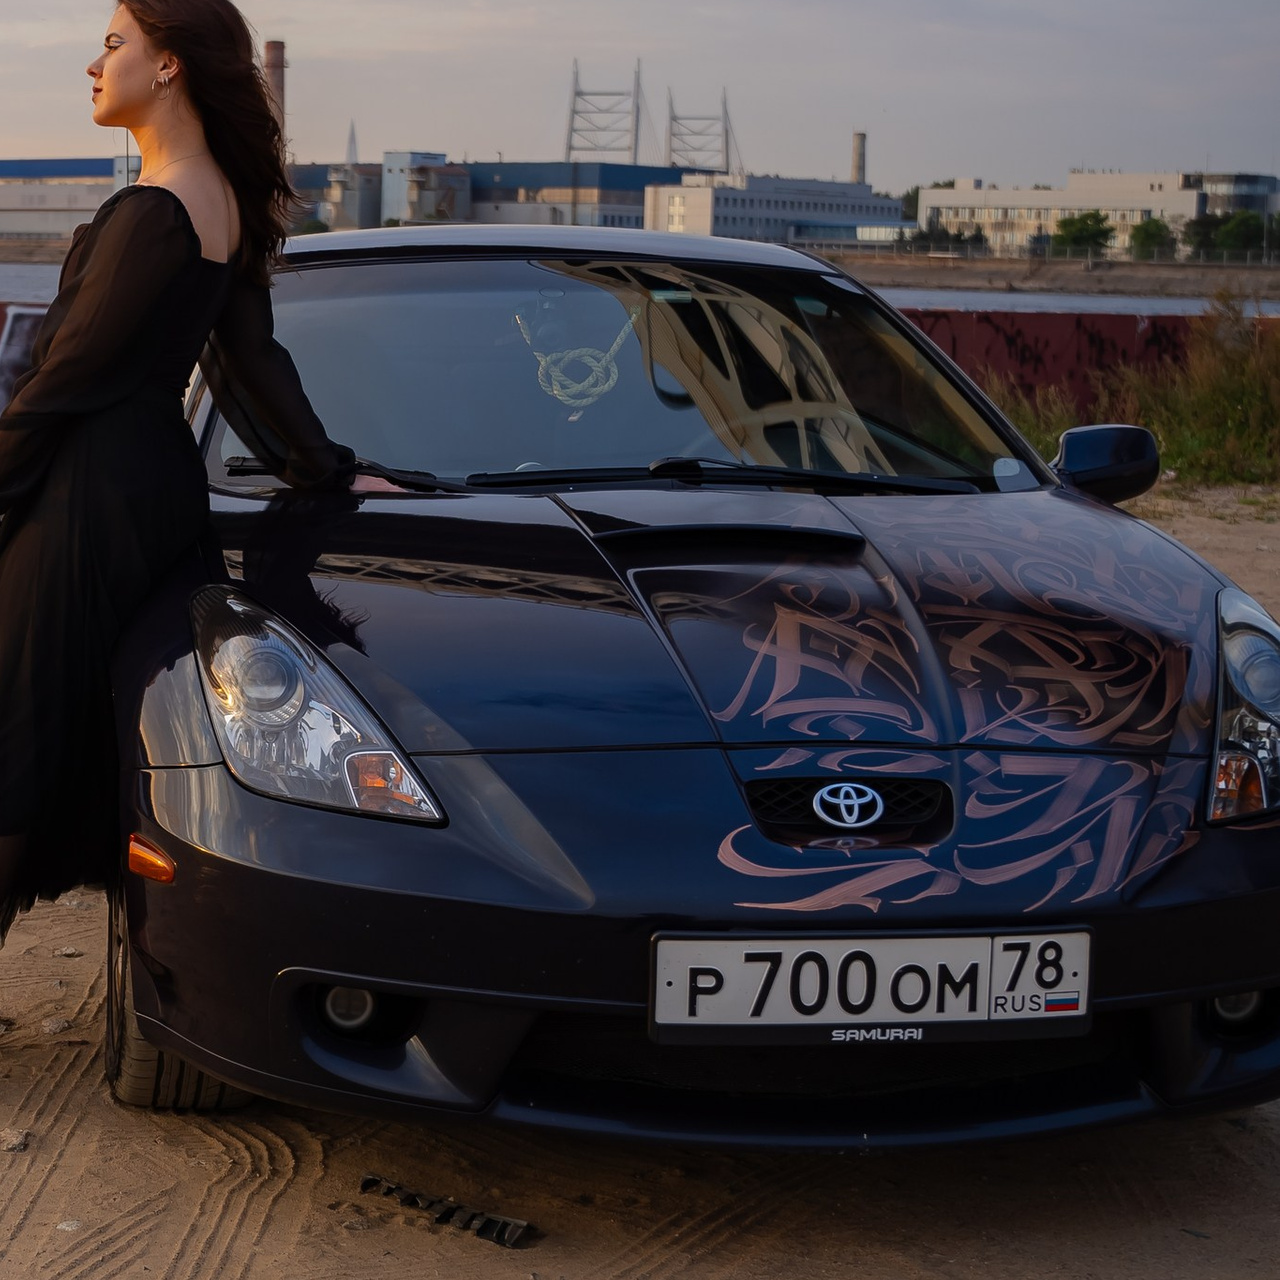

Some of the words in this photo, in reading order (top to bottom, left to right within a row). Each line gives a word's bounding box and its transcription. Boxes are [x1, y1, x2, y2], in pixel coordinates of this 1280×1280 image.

[1002, 940, 1064, 992] 78
[993, 994, 1042, 1013] RUS
[831, 1028, 923, 1041] SAMURAI
